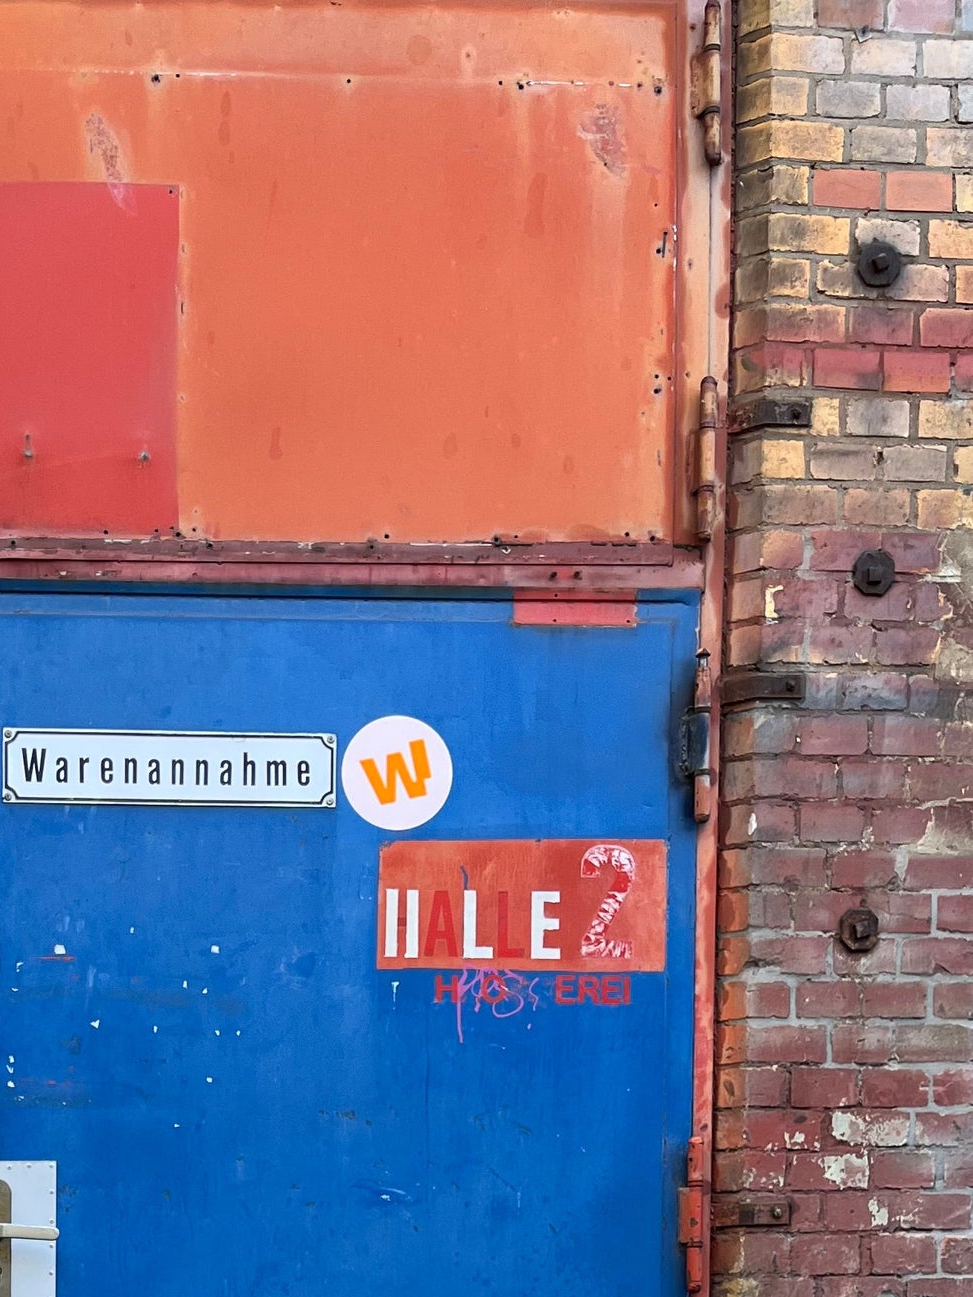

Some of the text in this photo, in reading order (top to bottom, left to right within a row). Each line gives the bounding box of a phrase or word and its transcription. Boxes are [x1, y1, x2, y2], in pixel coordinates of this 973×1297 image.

[21, 746, 311, 787] Warenannahme
[384, 844, 636, 960] HALLE 2
